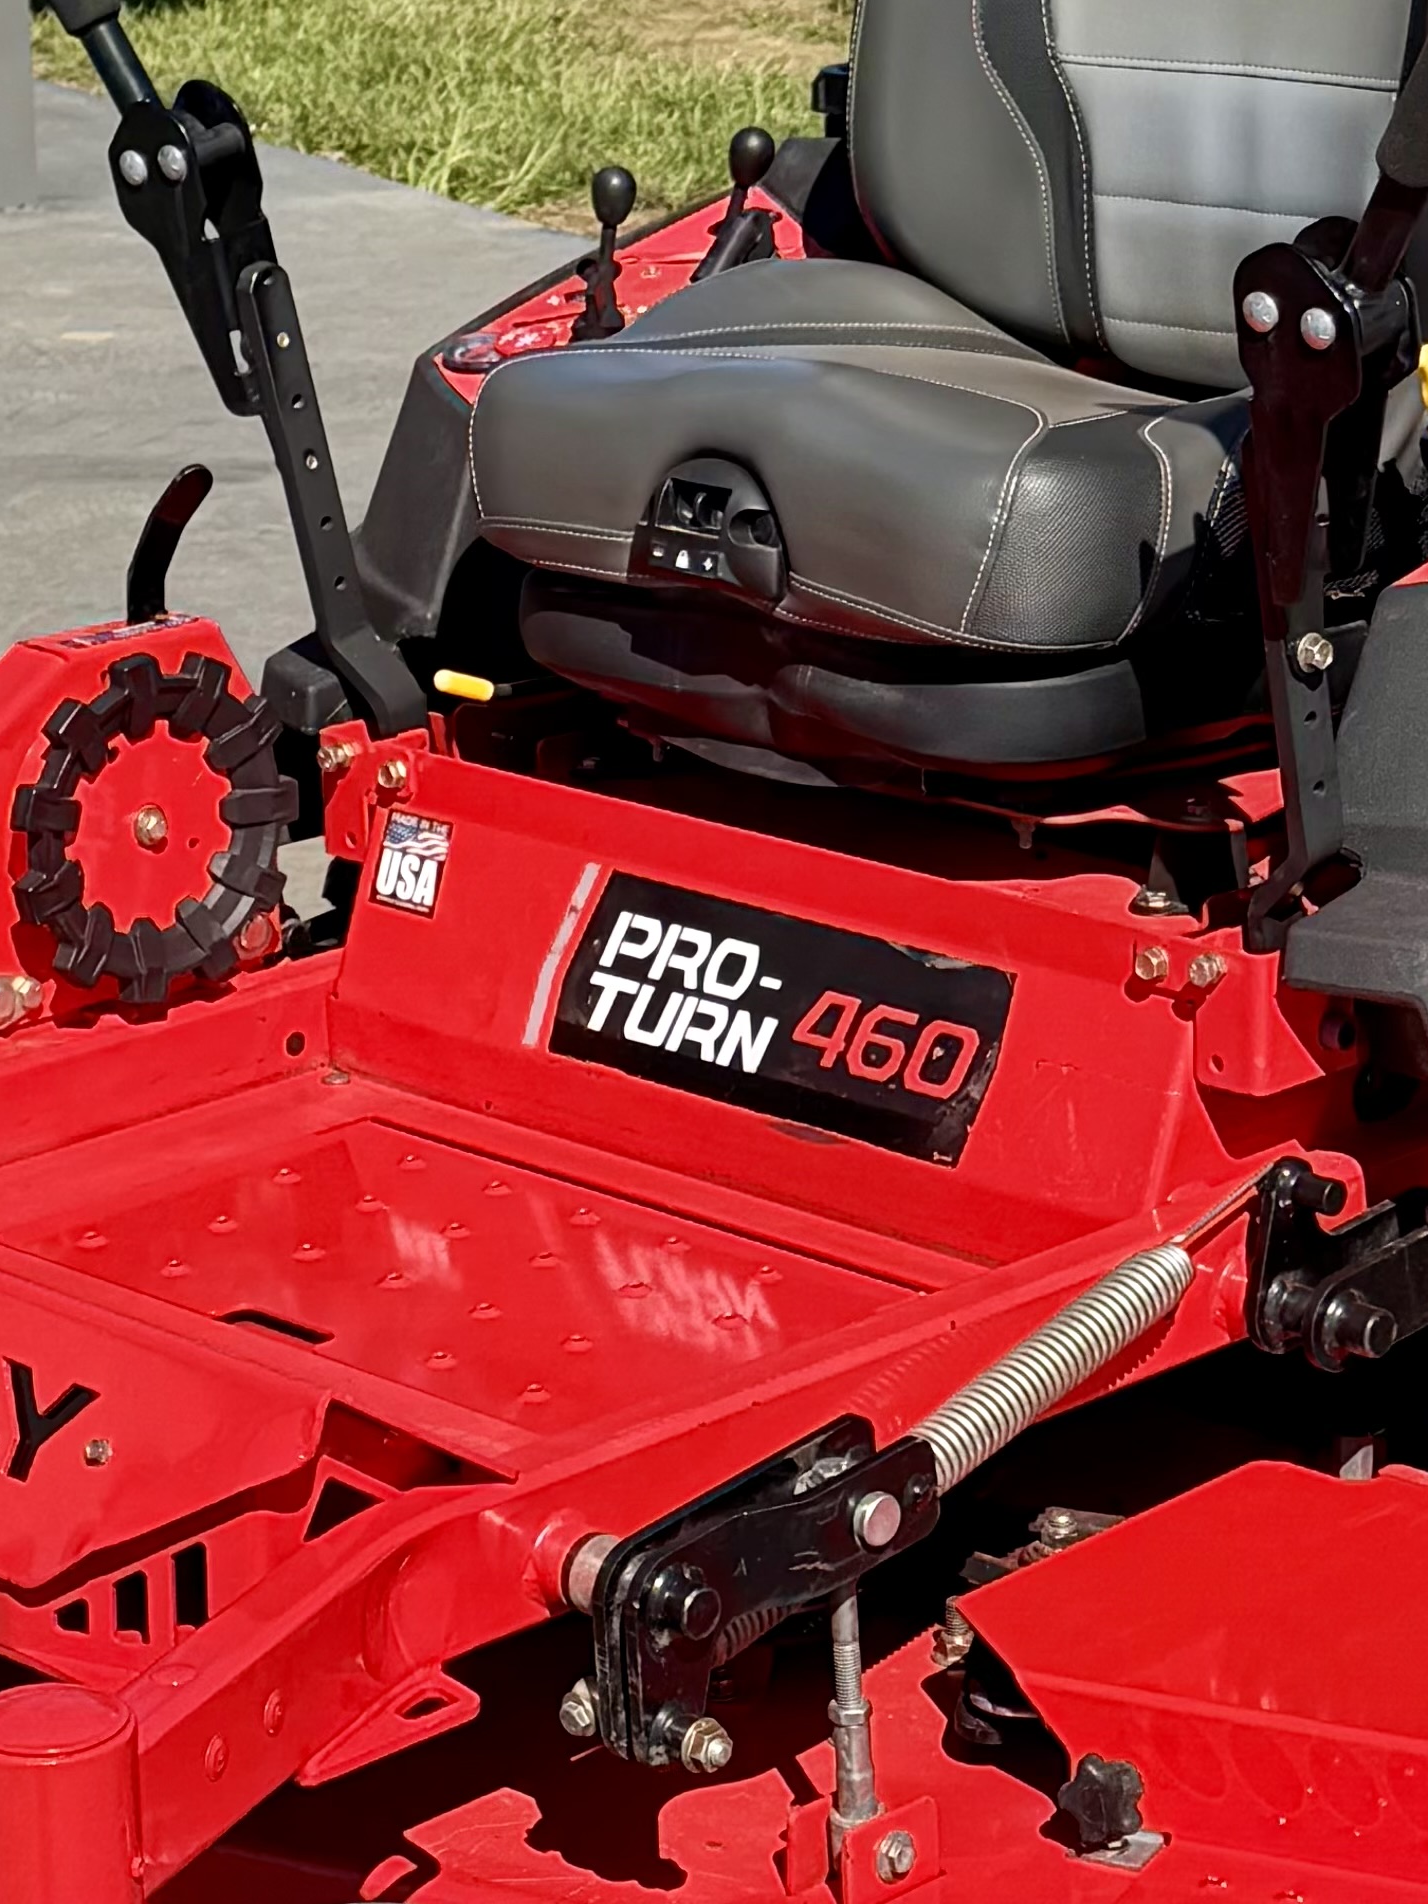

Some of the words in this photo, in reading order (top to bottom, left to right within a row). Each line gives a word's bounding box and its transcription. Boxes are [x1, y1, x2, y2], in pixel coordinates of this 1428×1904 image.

[375, 847, 438, 907] USA
[599, 911, 783, 1001] PRO-
[586, 971, 779, 1074] TURN
[791, 991, 979, 1100] 460
